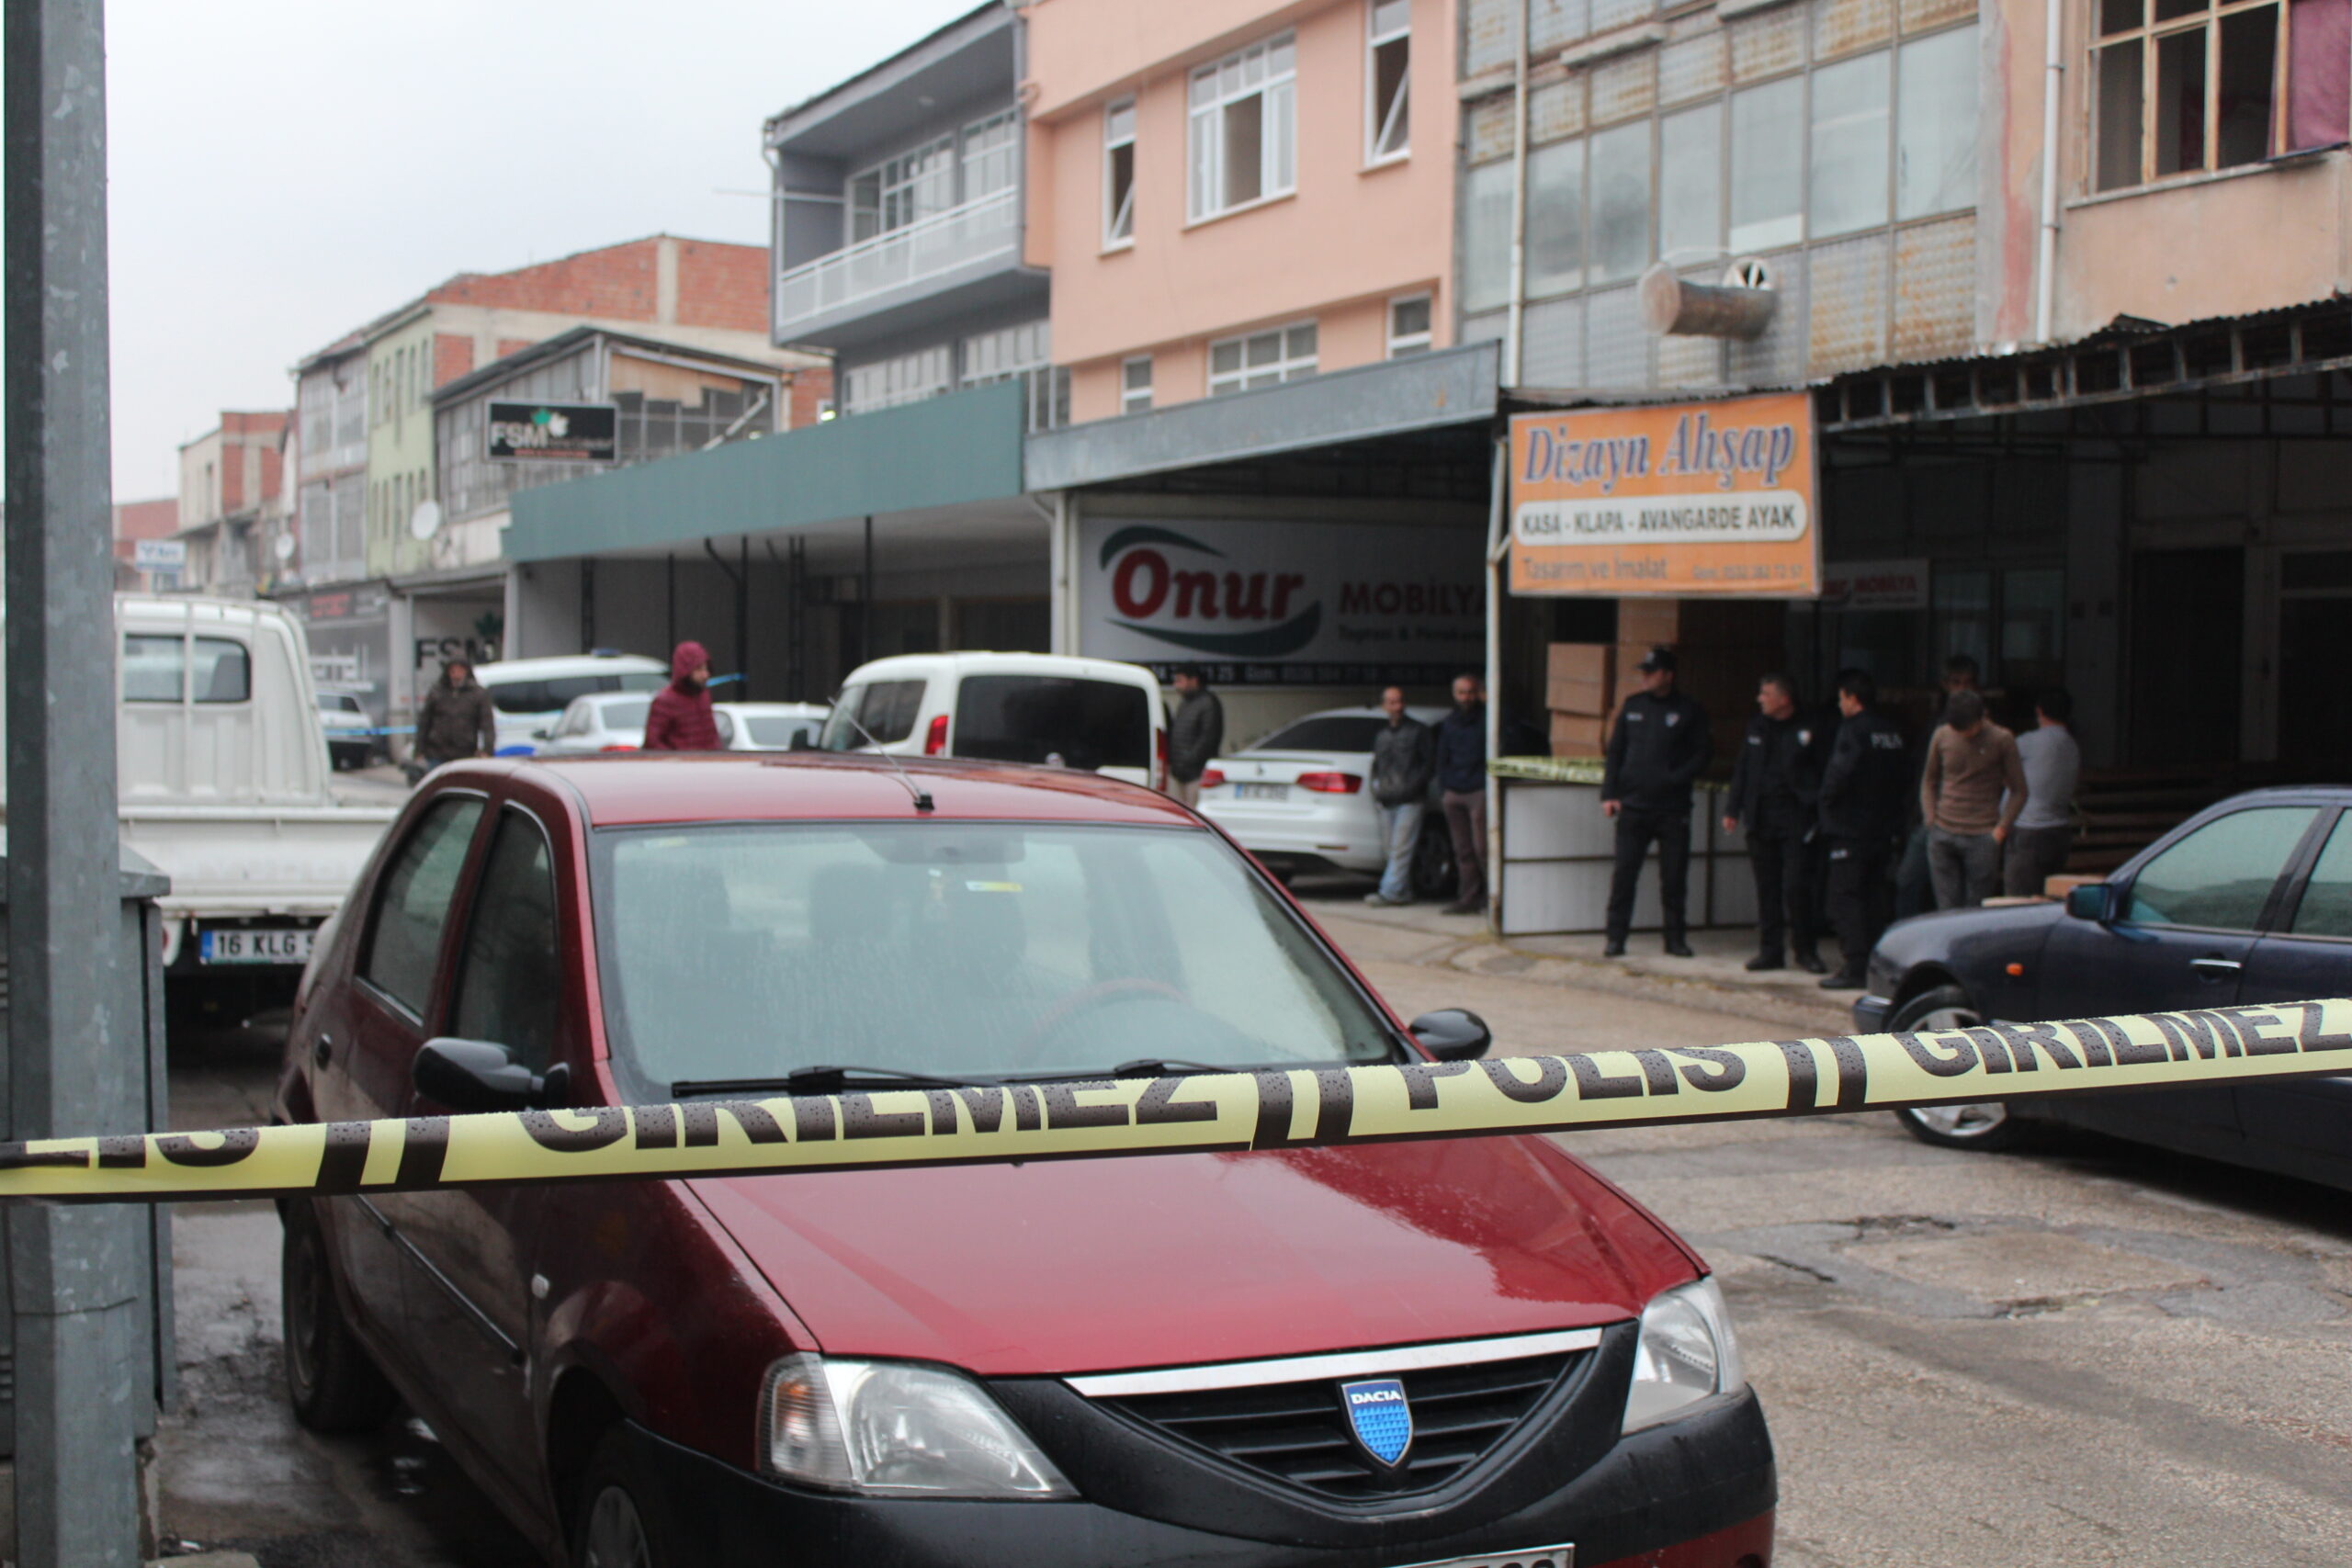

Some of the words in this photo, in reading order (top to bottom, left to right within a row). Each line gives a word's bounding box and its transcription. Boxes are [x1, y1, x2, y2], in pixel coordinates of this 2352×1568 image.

[491, 421, 548, 448] FSM
[1522, 423, 1649, 494] Dizayn
[1657, 412, 1794, 489] Ahşap
[1522, 512, 1561, 536] KASA
[1574, 511, 1624, 534] KLAPA
[1638, 507, 1741, 532] AVANGARDE
[1747, 505, 1795, 529] AYAK
[1113, 548, 1305, 620] Onur
[219, 934, 241, 954] 16
[253, 934, 295, 954] KLG
[1350, 1389, 1403, 1404] DACIA
